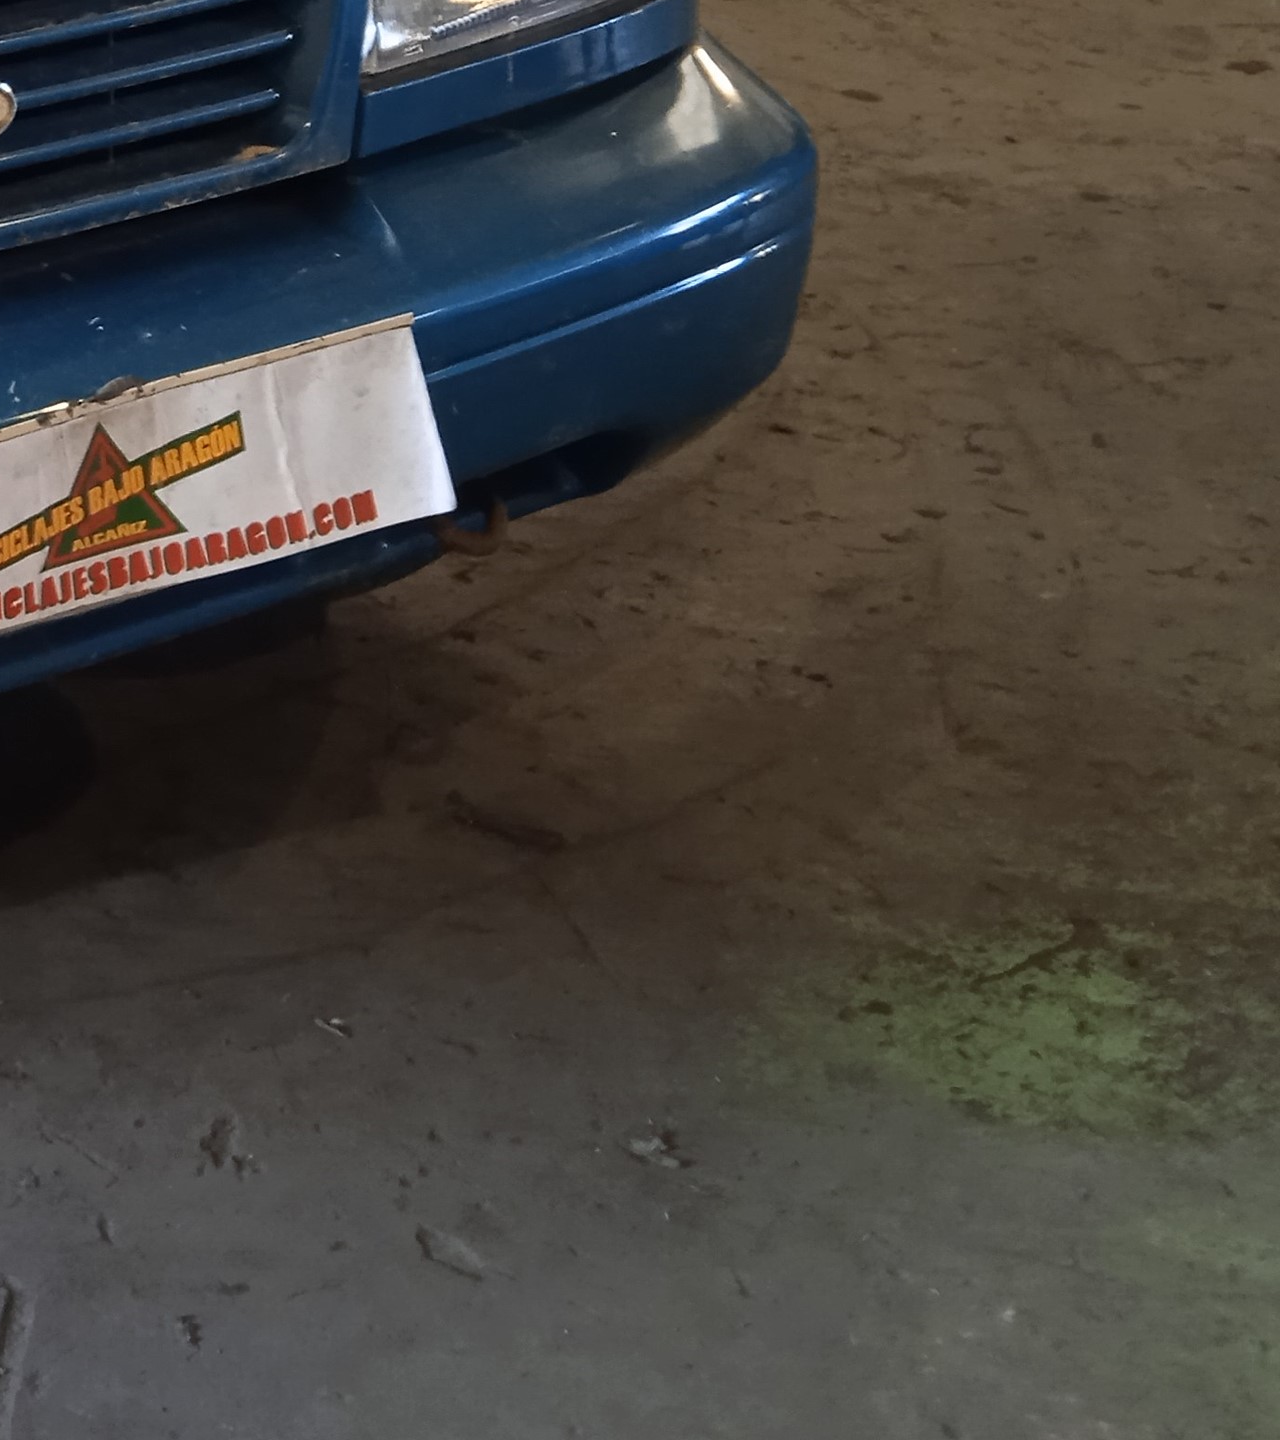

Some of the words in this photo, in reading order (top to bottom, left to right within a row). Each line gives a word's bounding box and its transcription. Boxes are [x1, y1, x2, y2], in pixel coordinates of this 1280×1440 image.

[86, 464, 145, 516] BAJO
[150, 419, 241, 486] ARAGÓN
[71, 519, 148, 553] ALCAÑIZ
